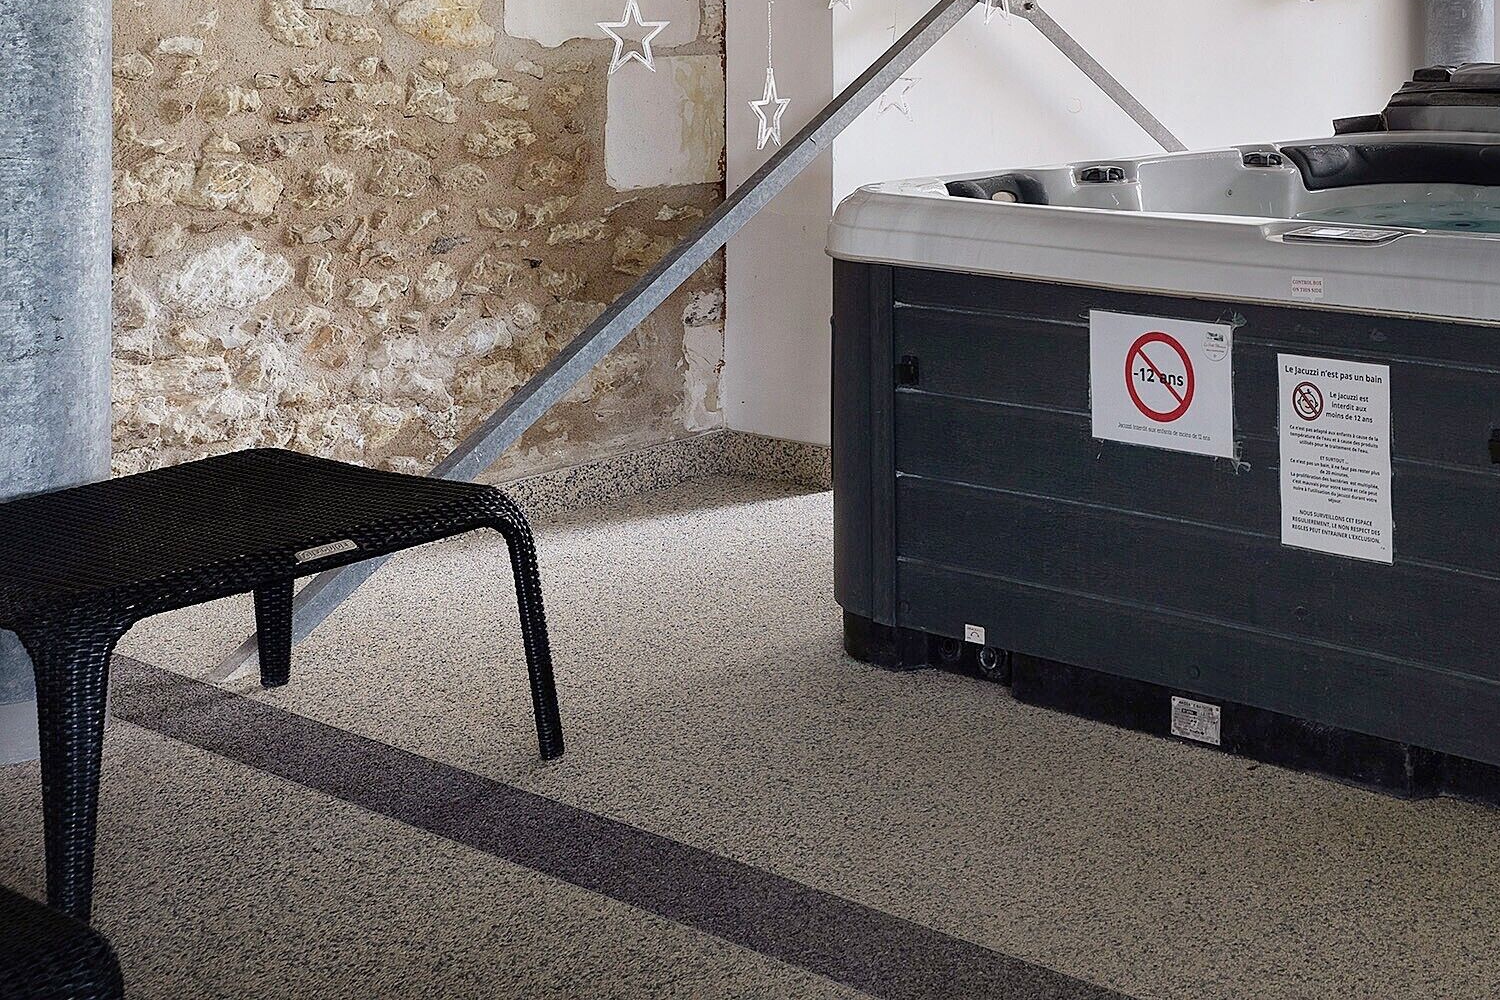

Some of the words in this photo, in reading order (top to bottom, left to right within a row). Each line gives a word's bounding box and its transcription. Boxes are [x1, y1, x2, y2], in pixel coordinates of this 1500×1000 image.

[1134, 368, 1154, 382] -12
[1160, 374, 1184, 386] ans
[1285, 365, 1294, 373] Le
[1321, 370, 1338, 379] n'est
[1340, 373, 1353, 381] pas
[1366, 375, 1383, 384] bain
[1326, 411, 1344, 419] moins
[1300, 509, 1313, 517] NOUS
[1355, 518, 1372, 527] ESPACE
